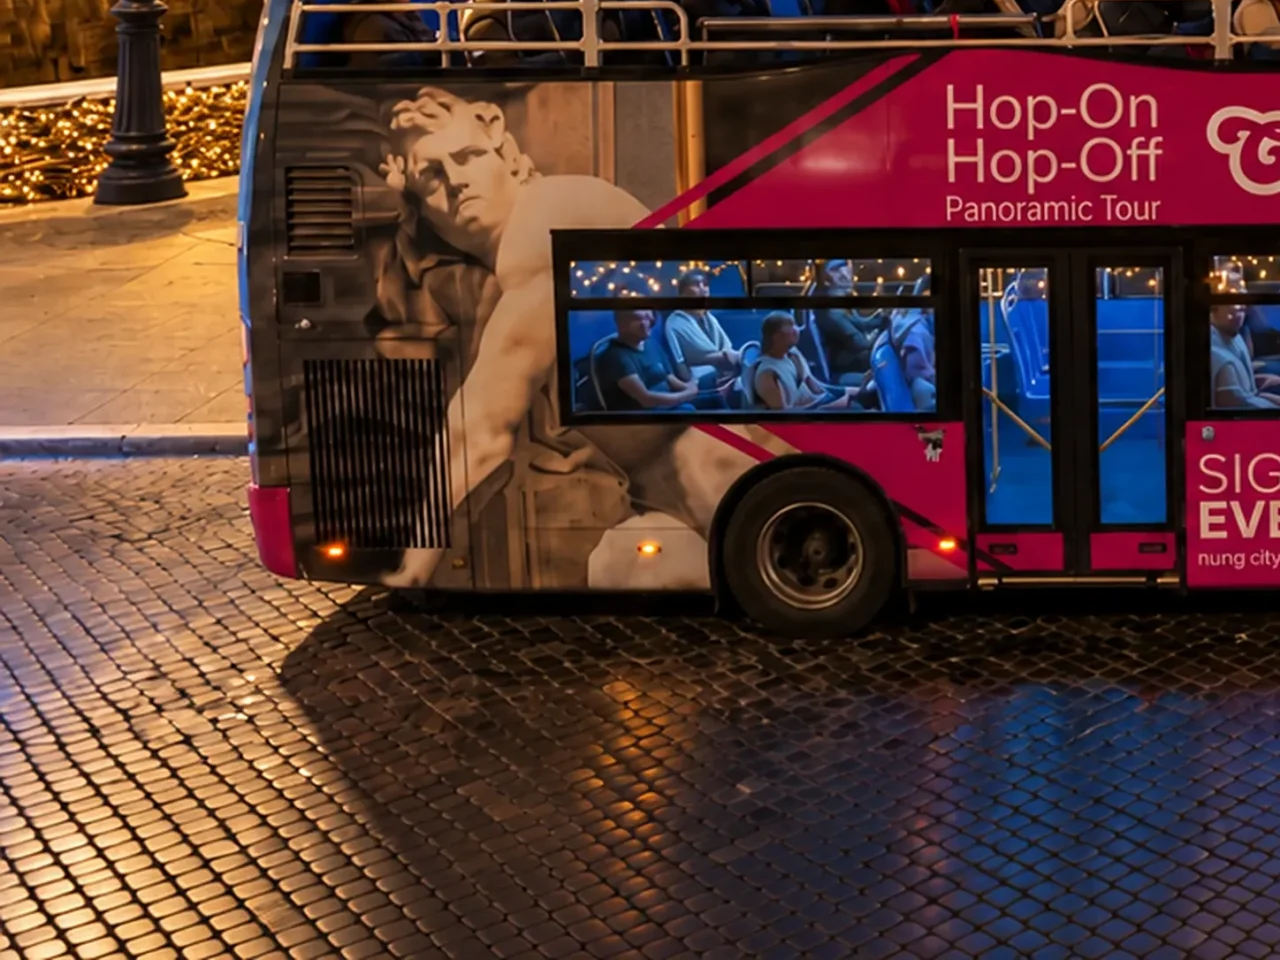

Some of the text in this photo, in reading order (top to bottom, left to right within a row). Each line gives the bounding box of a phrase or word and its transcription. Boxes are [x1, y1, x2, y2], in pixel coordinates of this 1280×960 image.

[947, 83, 1158, 139] Hop-On
[946, 137, 1163, 193] Hop-Off
[946, 195, 1161, 222] Panoramic Tour
